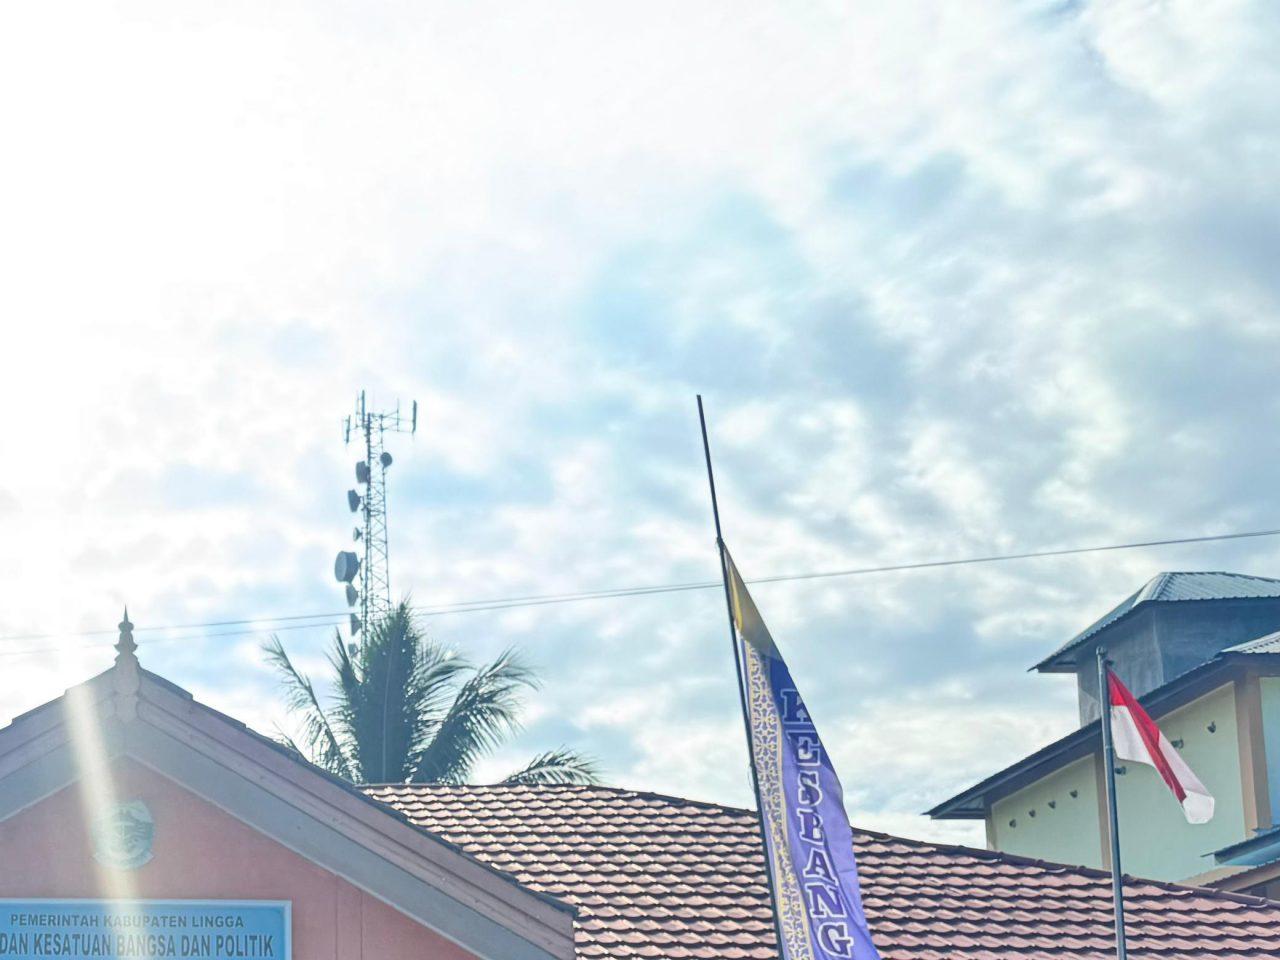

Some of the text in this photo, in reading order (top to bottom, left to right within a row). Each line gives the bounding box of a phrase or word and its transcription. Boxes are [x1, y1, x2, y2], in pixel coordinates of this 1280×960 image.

[10, 913, 244, 928] PEMERINTAH KABUPATEN LINGGA
[33, 933, 111, 956] KESATUAN
[116, 934, 176, 957] BANGSA
[180, 935, 210, 957] DAN
[215, 935, 274, 958] POLITIK
